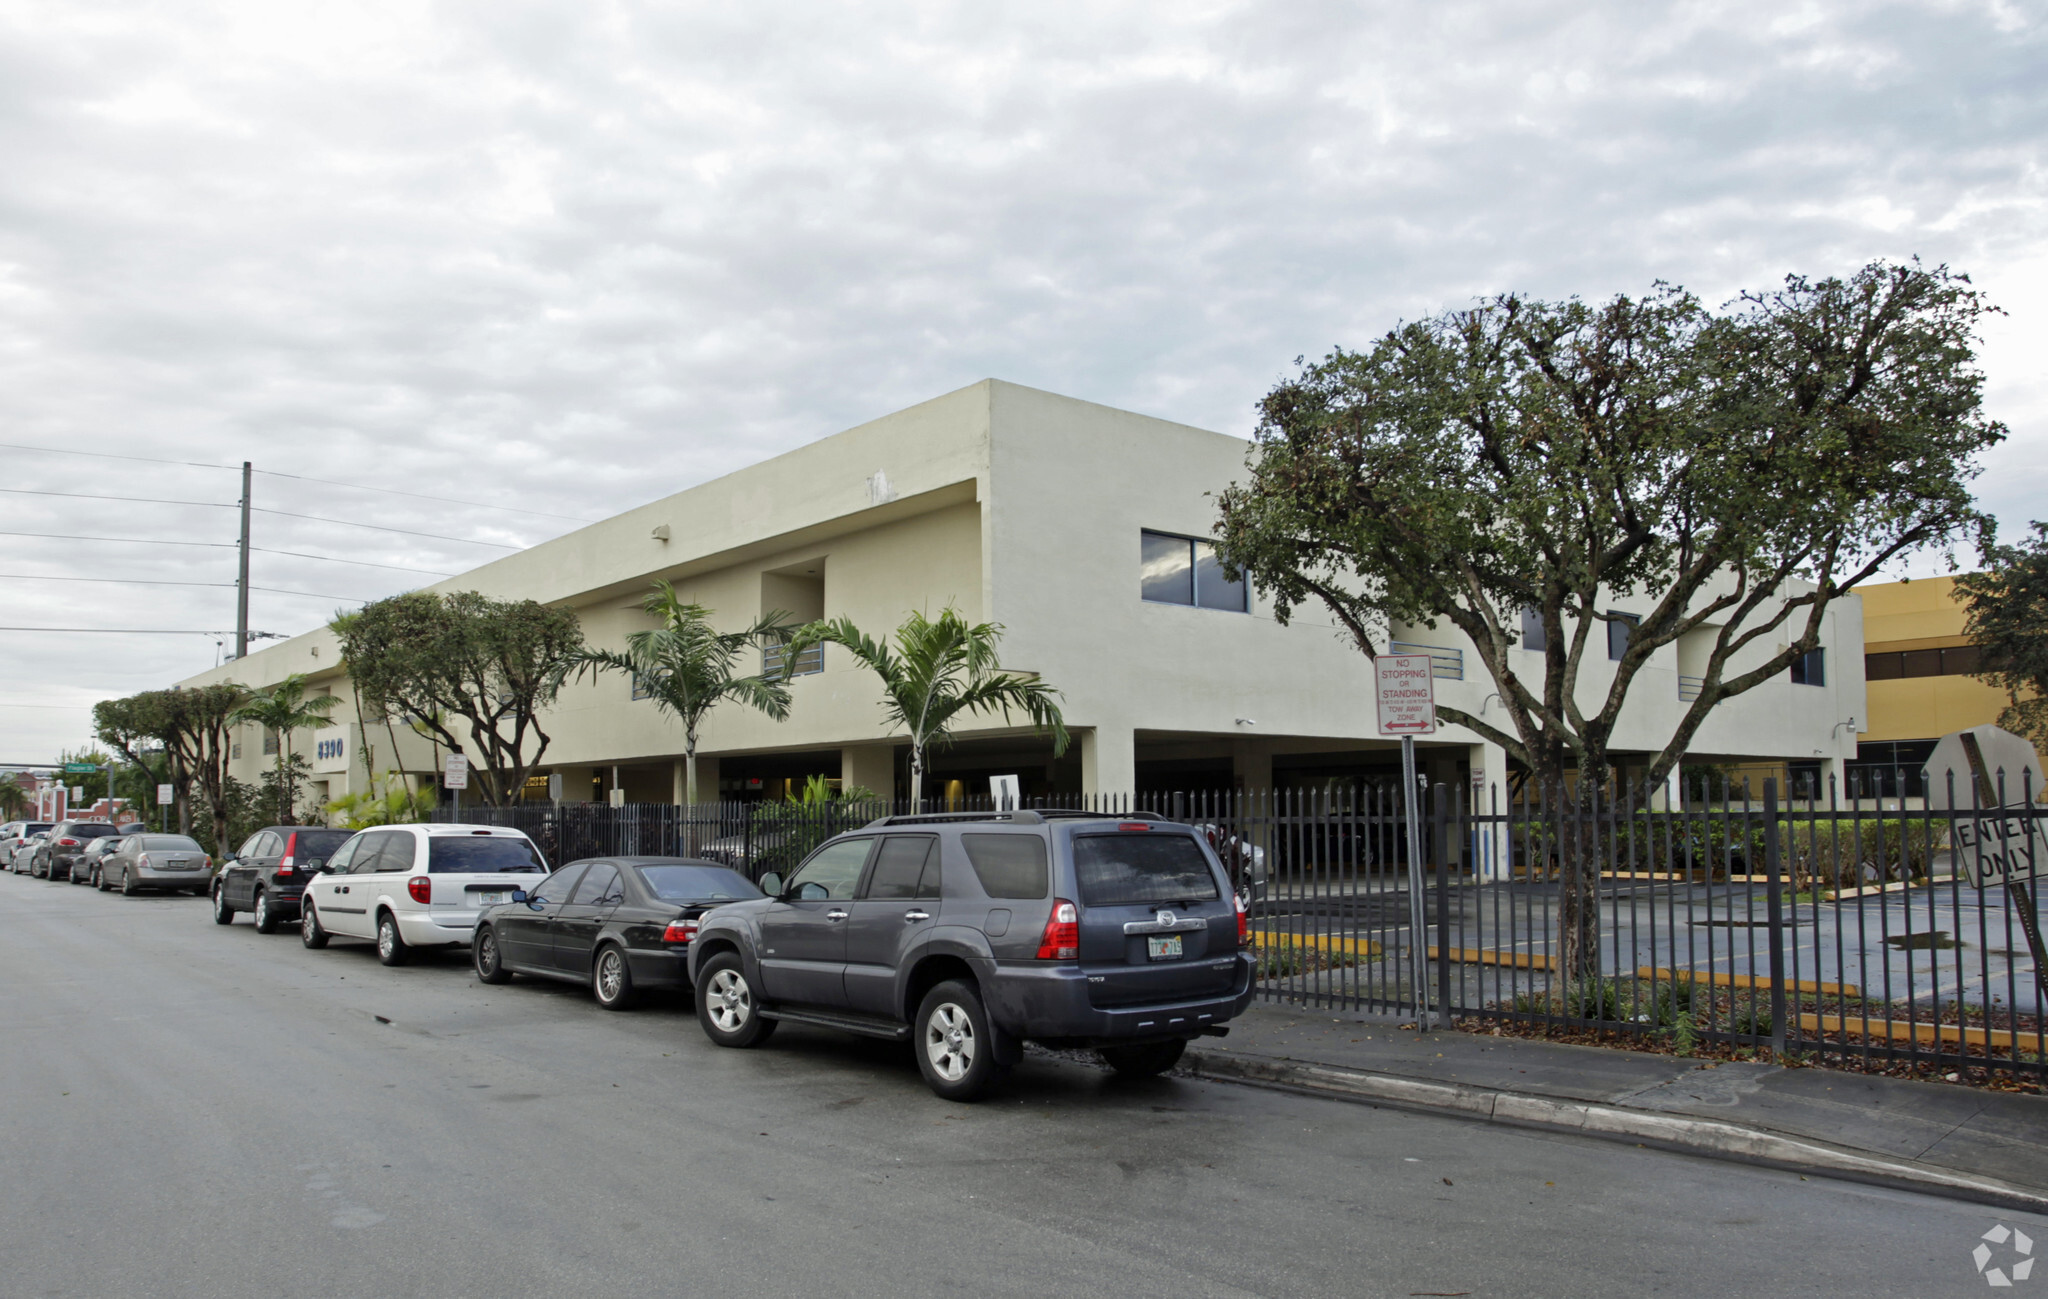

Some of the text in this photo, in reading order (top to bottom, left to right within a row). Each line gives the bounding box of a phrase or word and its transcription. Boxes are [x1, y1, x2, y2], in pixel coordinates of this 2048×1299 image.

[1396, 659, 1410, 668] NO
[1382, 669, 1426, 679] STOPPING
[1382, 689, 1428, 699] STANDING
[1388, 705, 1424, 713] TOW AWAY
[317, 737, 344, 760] 8390
